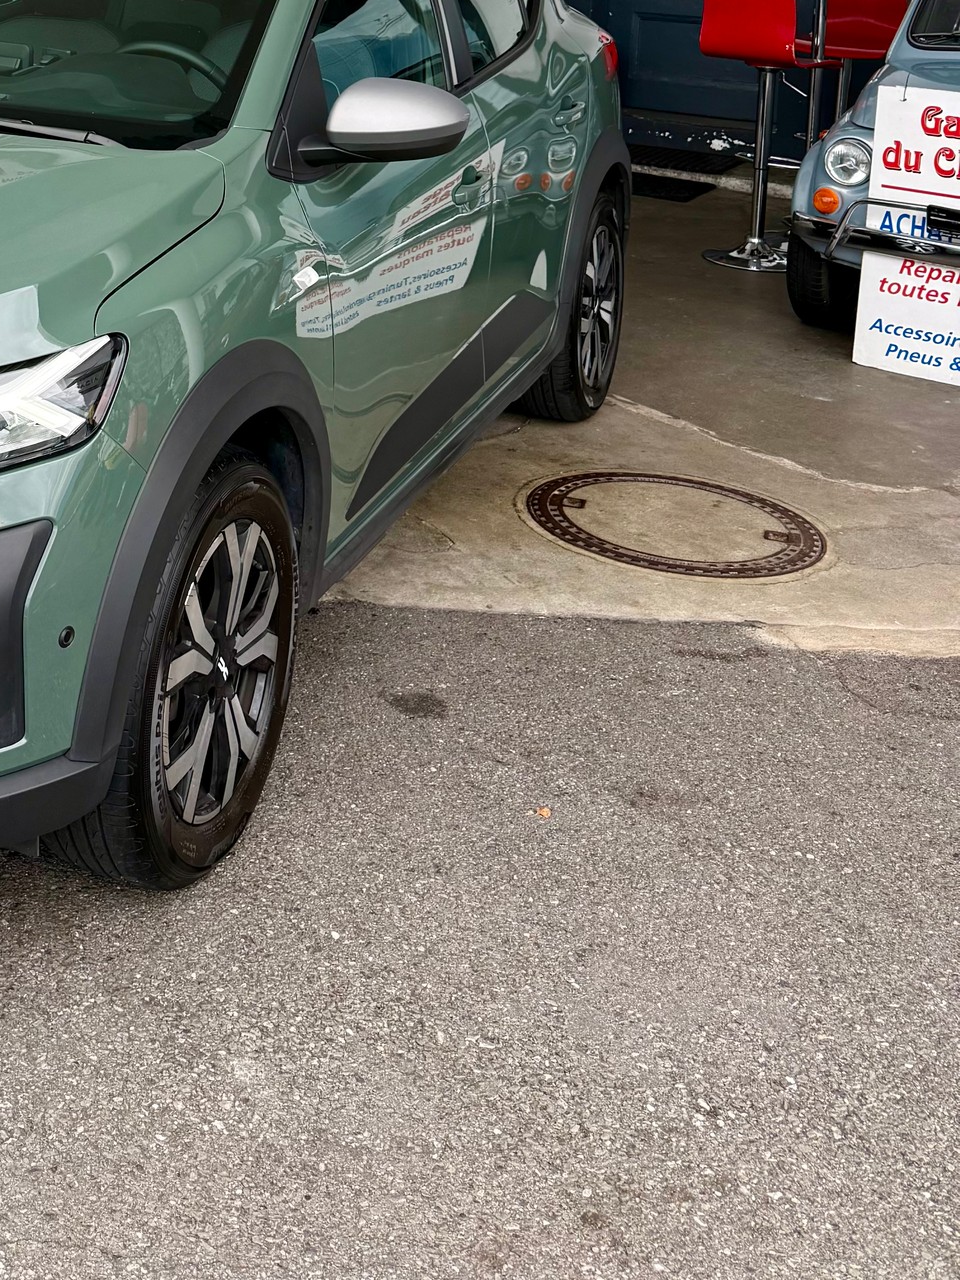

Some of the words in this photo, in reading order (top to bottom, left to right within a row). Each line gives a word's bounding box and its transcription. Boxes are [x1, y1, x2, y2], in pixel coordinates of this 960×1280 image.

[882, 140, 923, 174] du
[879, 278, 951, 304] toutes
[885, 343, 943, 367] Pneus
